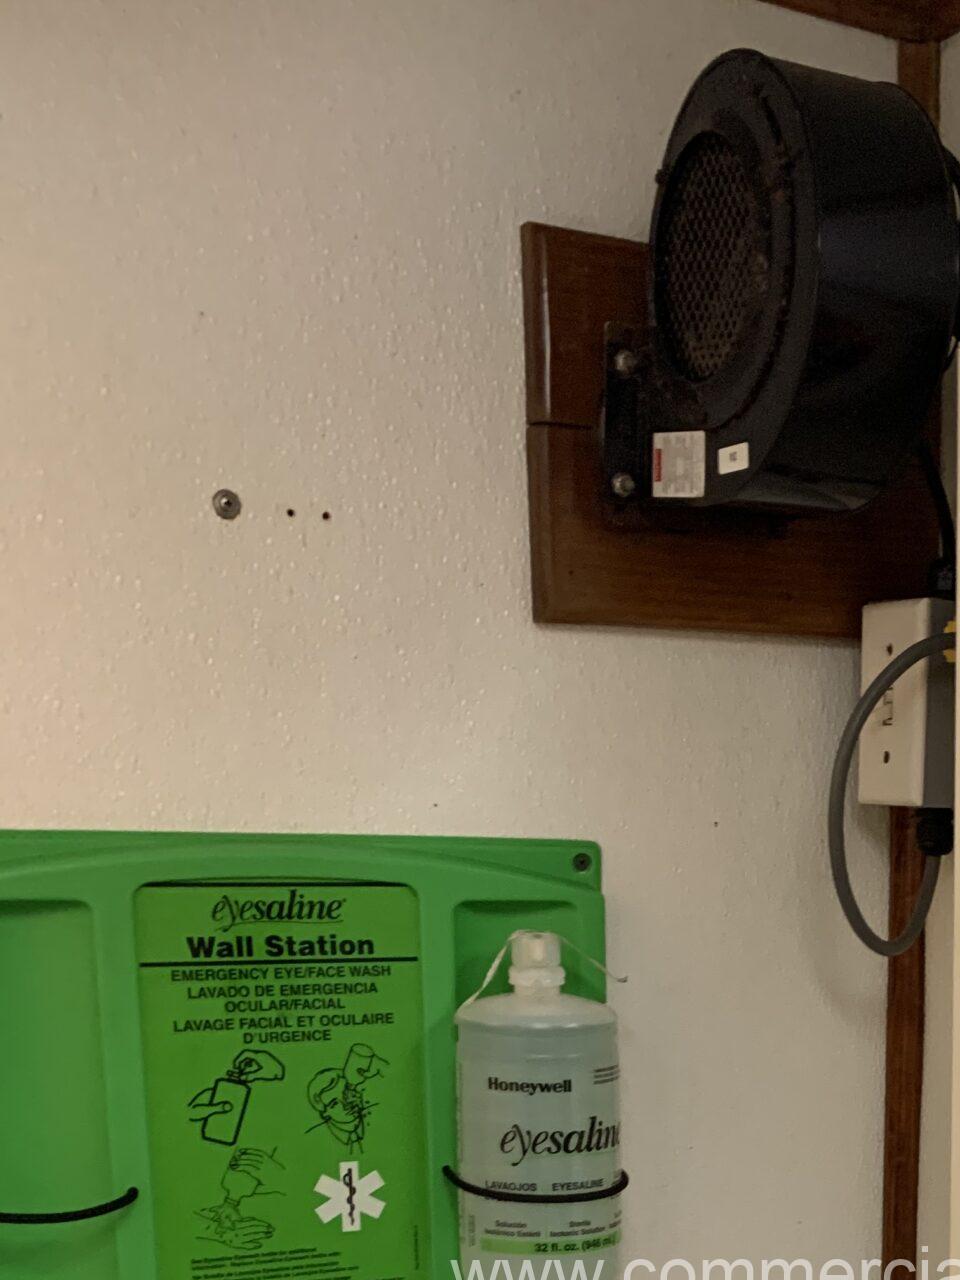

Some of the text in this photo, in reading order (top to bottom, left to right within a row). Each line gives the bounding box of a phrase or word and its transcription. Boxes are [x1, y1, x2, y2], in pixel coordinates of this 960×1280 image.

[211, 889, 344, 932] eyesaline
[186, 934, 375, 958] Wall Station
[171, 965, 391, 982] EMERGENCY EYE/FACE WASH
[187, 983, 378, 1000] LAVADO DE EMERGENCIA
[225, 999, 345, 1013] OCULAR/FACIAL
[173, 1013, 395, 1033] LAVAGE FACIAL ET OCULAIRE
[243, 1029, 332, 1044] D'URGENCE
[488, 1076, 572, 1095] Honeywell
[485, 1180, 537, 1192] LAVAOJOS
[551, 1178, 604, 1191] EYESALINE
[534, 1243, 548, 1252] 32
[551, 1242, 561, 1252] fl.
[564, 1243, 579, 1252] oz.
